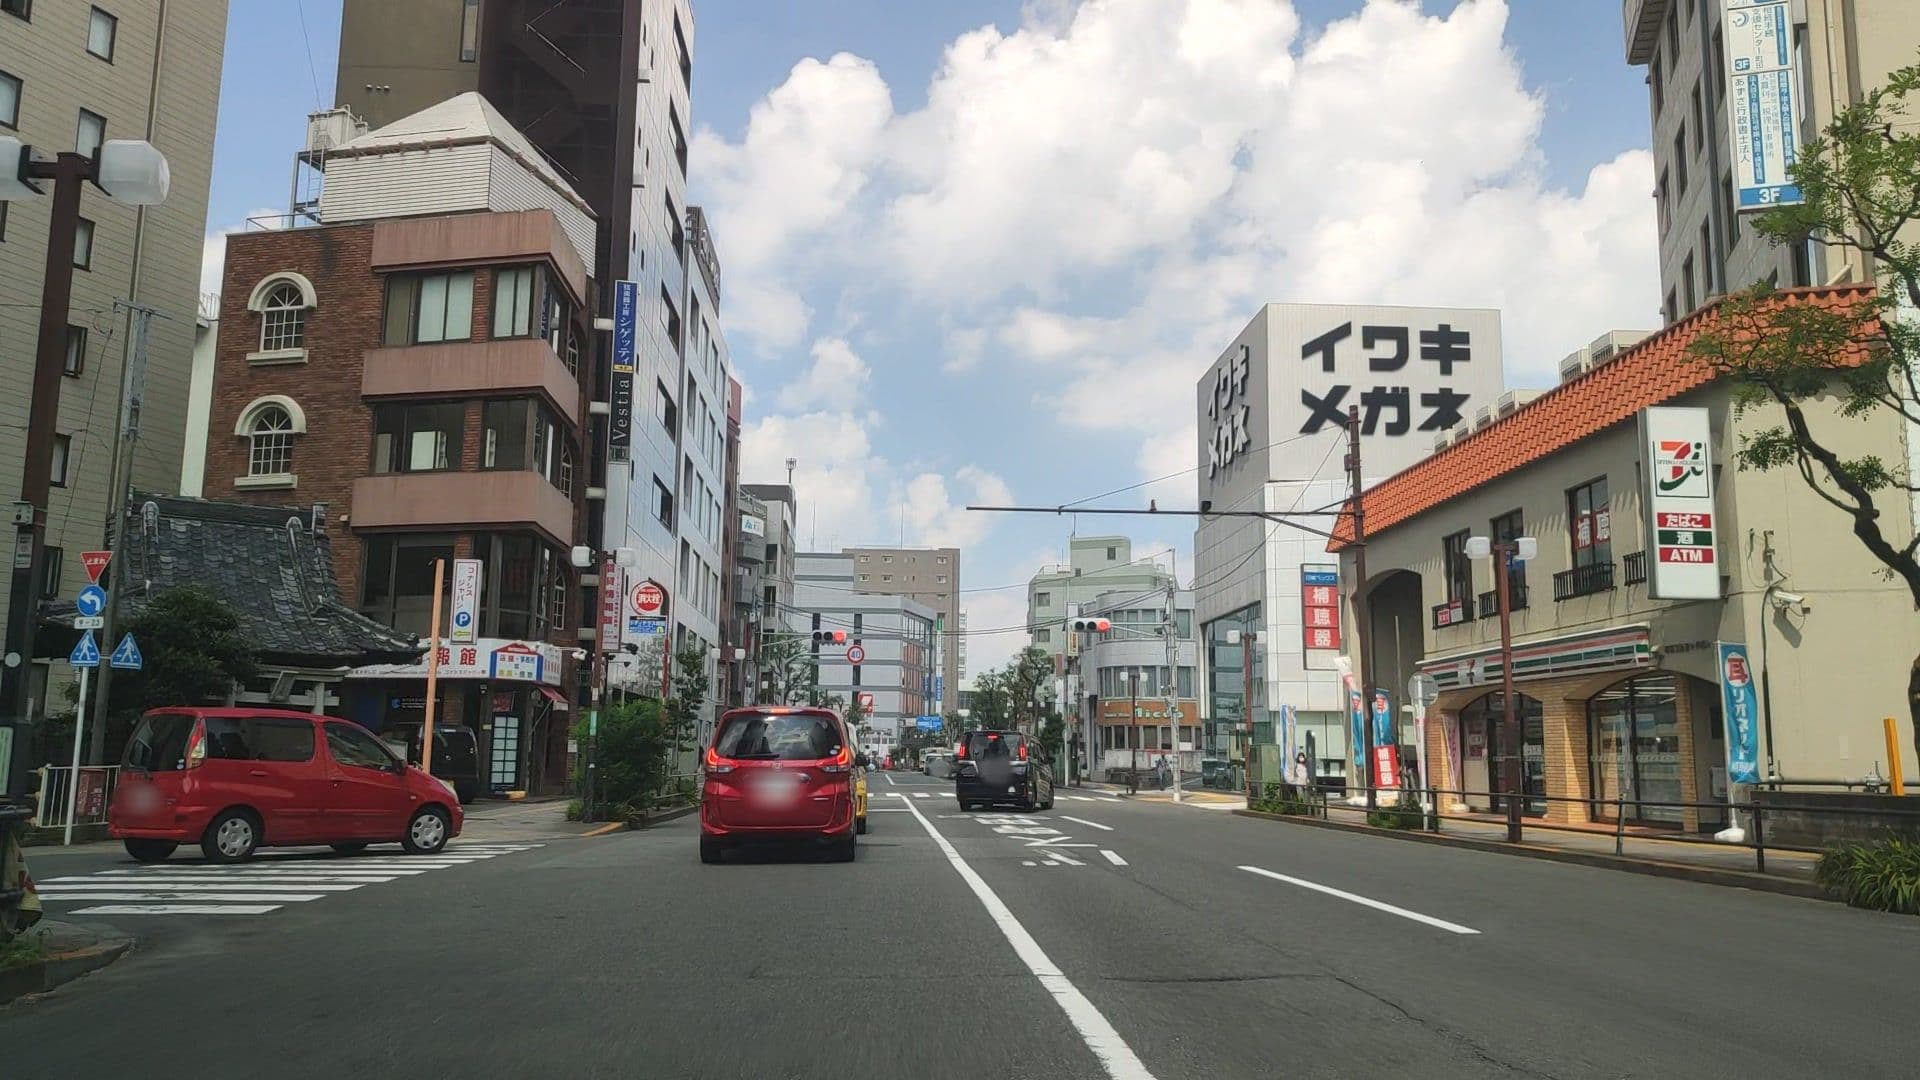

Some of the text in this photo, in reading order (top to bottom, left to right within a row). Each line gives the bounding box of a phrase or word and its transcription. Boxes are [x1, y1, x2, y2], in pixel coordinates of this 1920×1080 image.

[1736, 59, 1750, 70] 3F
[1759, 188, 1781, 203] 3F
[618, 317, 632, 366] シゲッティ
[1301, 320, 1471, 376] イワキ
[1208, 343, 1250, 422] イワキ
[612, 379, 630, 441] Vestia
[1299, 384, 1472, 436] メガネ
[1207, 404, 1251, 480] メガネ
[1665, 513, 1704, 528] たばこ
[1676, 531, 1694, 545] 酒
[86, 558, 106, 566] 止まれ
[1670, 549, 1703, 562] ATM
[637, 592, 662, 605] 消火栓
[1312, 585, 1332, 647] 補聴器
[850, 650, 861, 659] 40
[1727, 657, 1748, 683] 耳
[1732, 688, 1750, 761] リオネット
[1377, 748, 1394, 785] 補聴器
